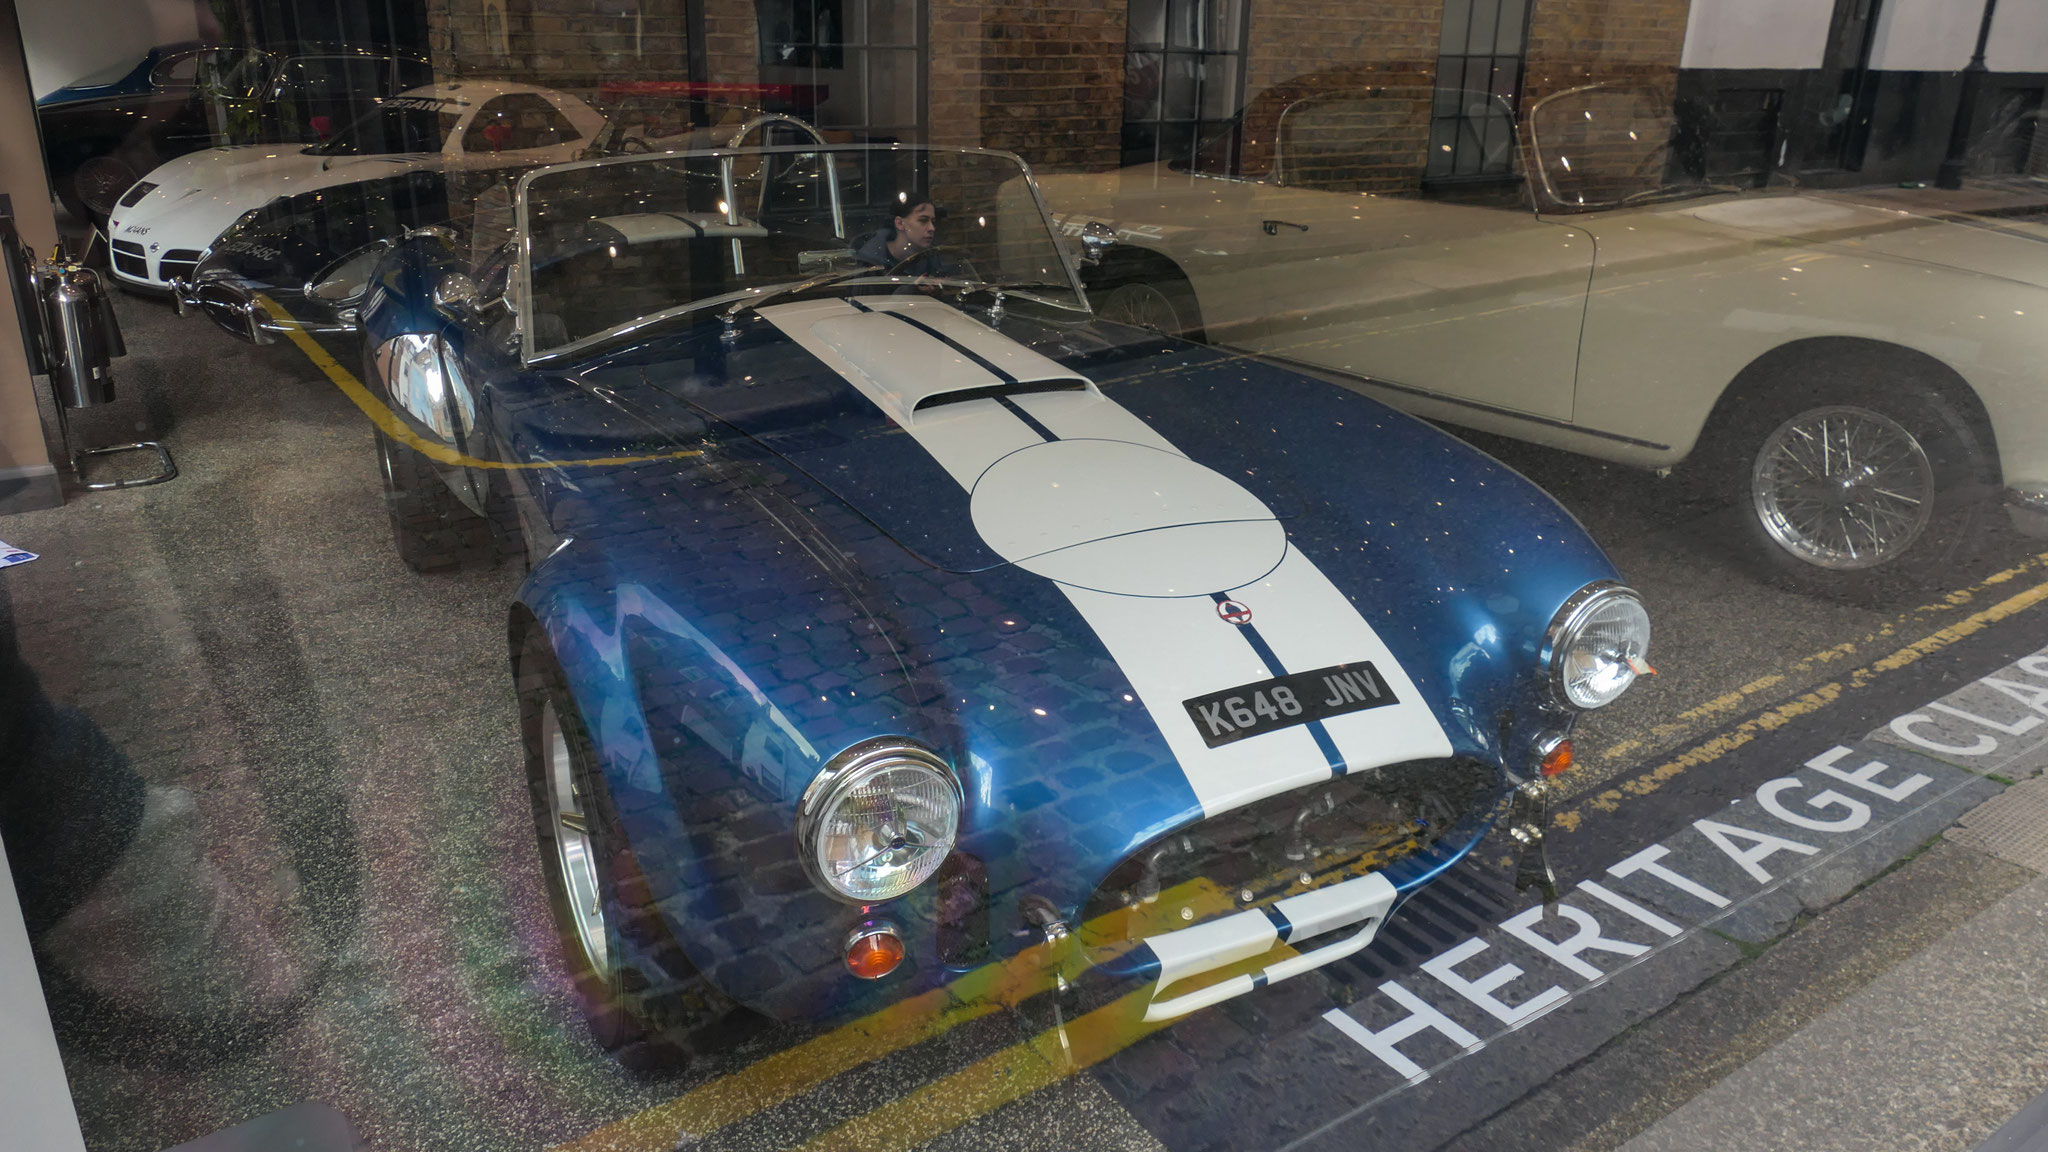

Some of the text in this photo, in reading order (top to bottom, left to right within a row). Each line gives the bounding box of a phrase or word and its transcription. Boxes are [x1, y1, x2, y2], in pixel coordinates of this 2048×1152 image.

[1198, 669, 1382, 736] K648 JNV
[1322, 745, 1934, 1085] HERITAGE
